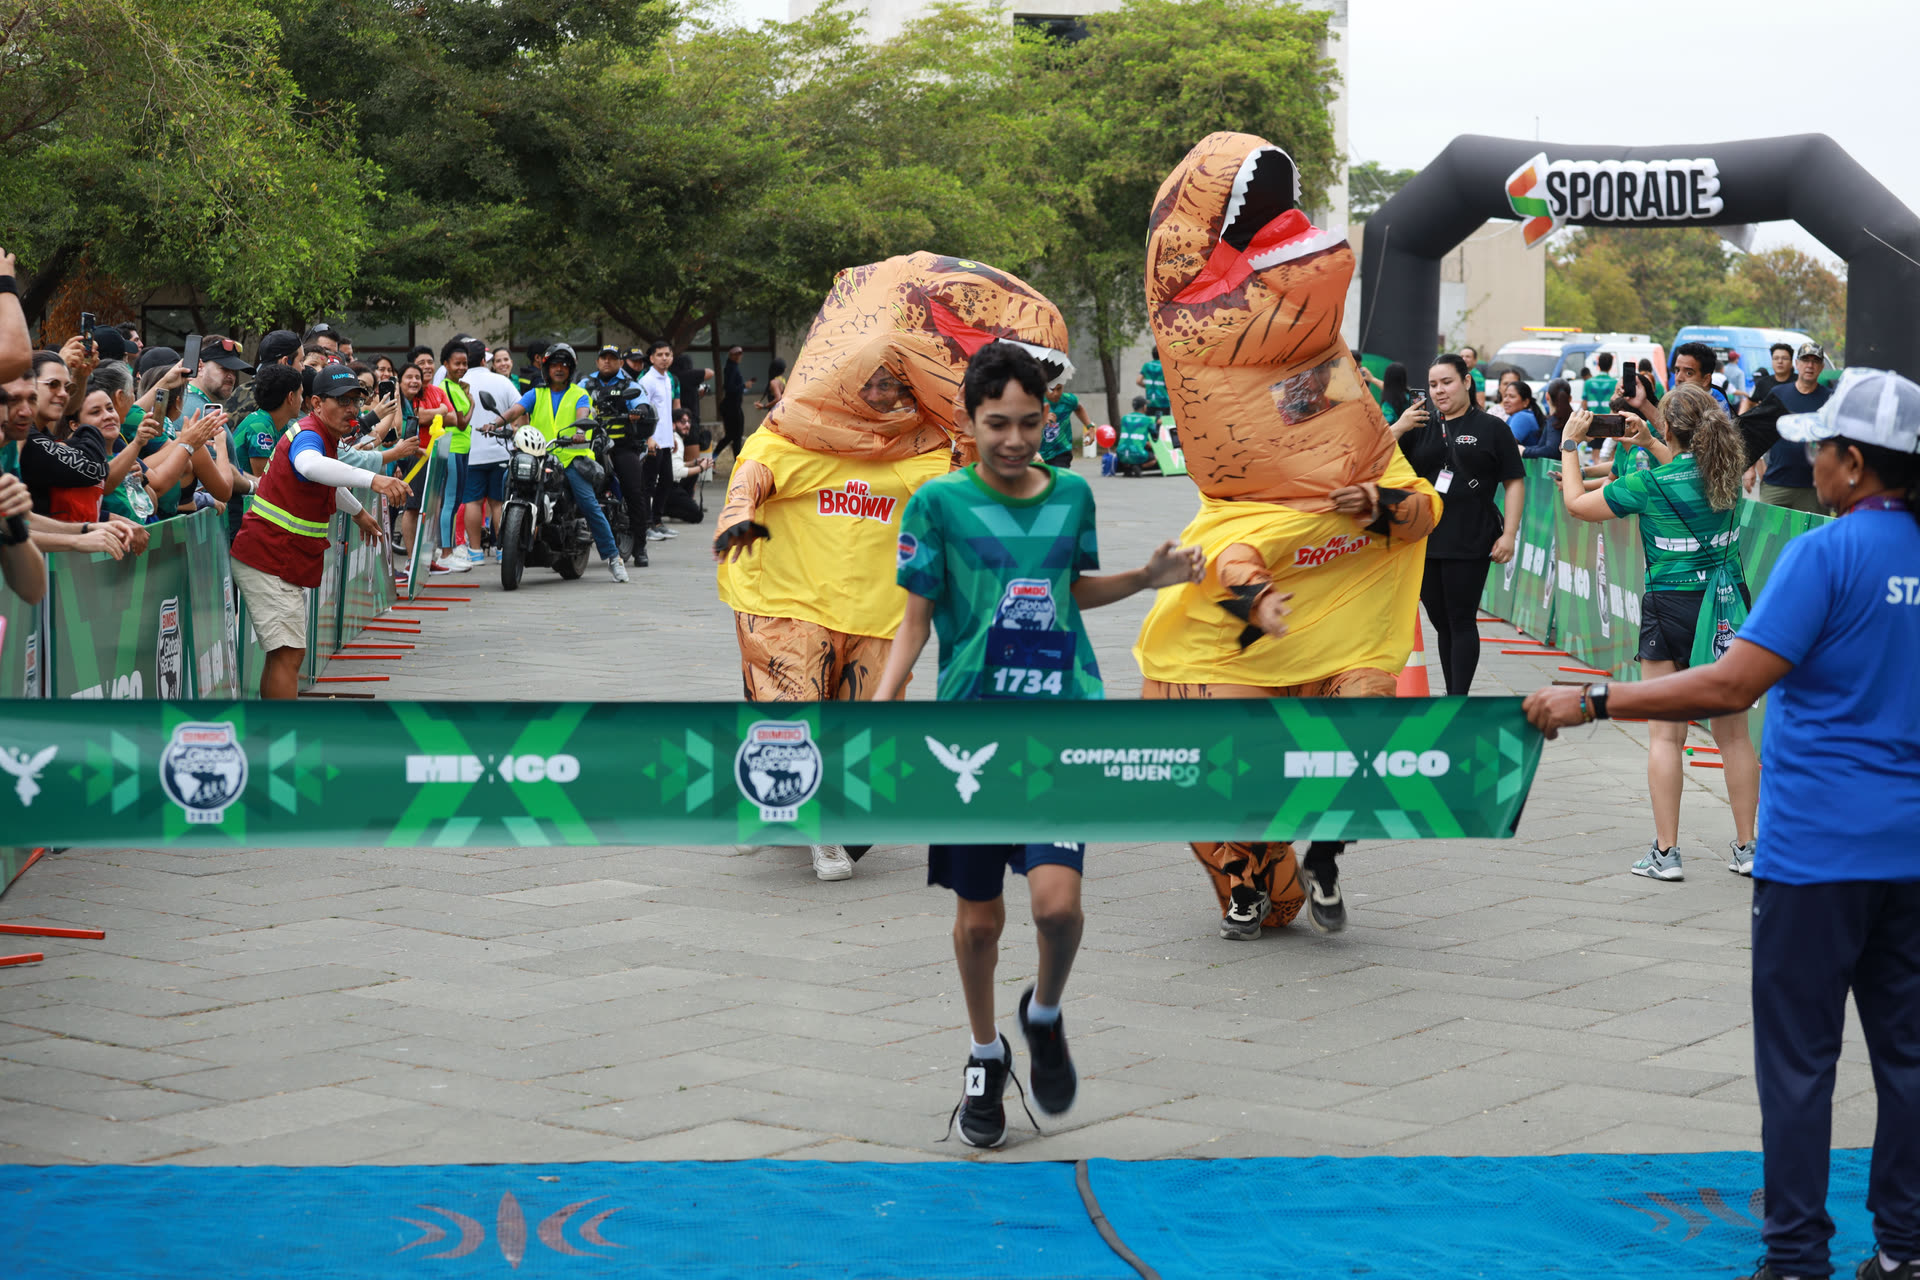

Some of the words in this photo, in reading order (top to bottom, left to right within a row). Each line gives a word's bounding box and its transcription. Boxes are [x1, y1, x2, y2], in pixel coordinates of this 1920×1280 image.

[1546, 169, 1711, 218] SPORADE
[846, 481, 869, 496] MR.
[818, 489, 896, 522] BROWN
[1013, 585, 1047, 596] BIMBO
[1014, 599, 1051, 612] Global
[162, 610, 177, 630] BIMBO
[1003, 608, 1035, 620] Race
[993, 667, 1063, 695] 1734
[757, 729, 803, 741] BIMBO
[760, 745, 810, 760] Global
[1060, 748, 1201, 764] COMPARTIMOS
[749, 756, 791, 772] Race
[1103, 764, 1121, 778] LO
